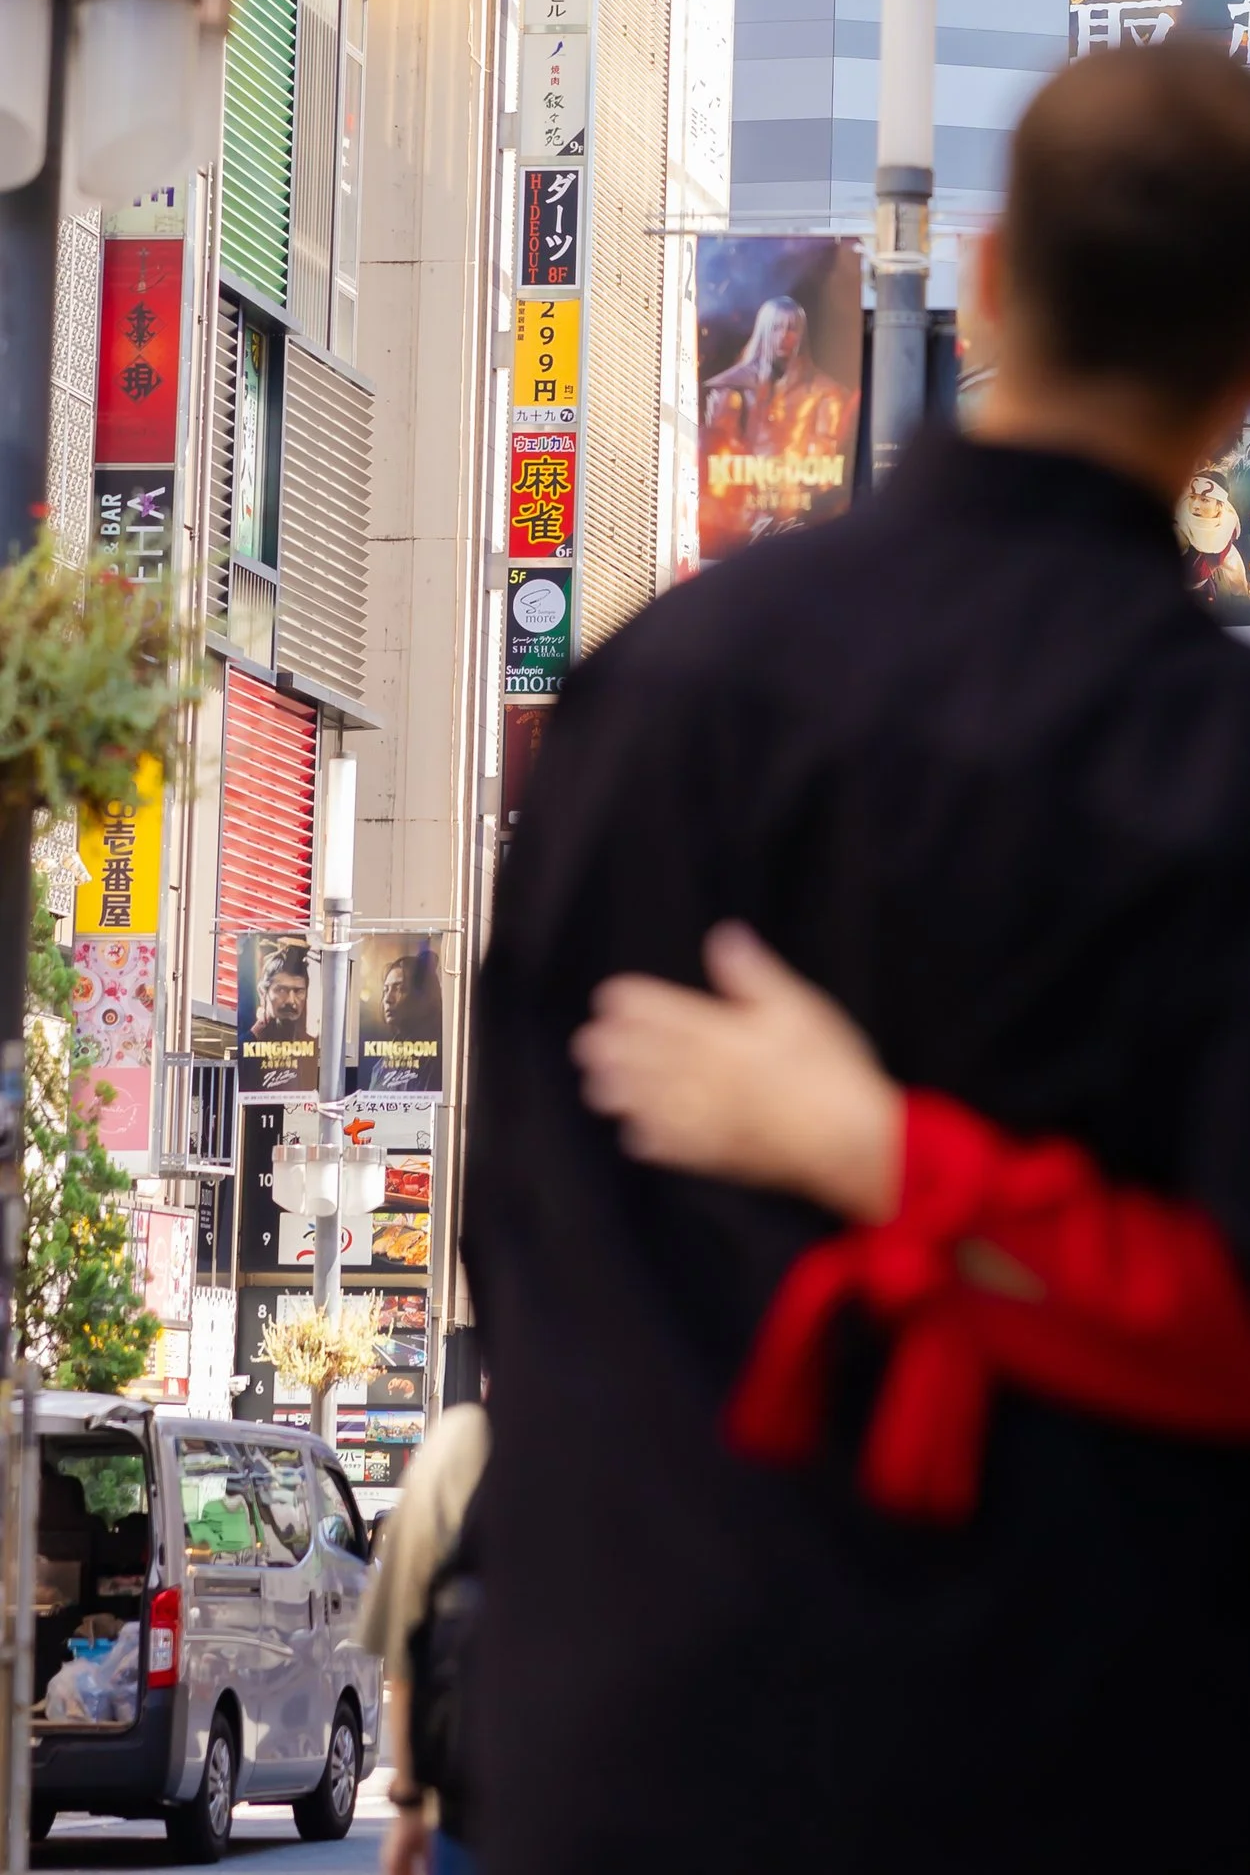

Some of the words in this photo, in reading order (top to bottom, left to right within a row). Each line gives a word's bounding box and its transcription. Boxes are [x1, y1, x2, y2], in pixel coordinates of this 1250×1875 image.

[551, 65, 560, 86] 焼肉
[569, 140, 584, 153] 9F
[545, 173, 577, 262] ダーツ
[528, 173, 541, 284] HIDEOUT
[548, 266, 568, 283] 8F
[533, 301, 557, 402] 299円
[516, 409, 557, 423] 九十九
[513, 434, 575, 454] ウェルカム
[707, 453, 845, 487] KINGDOM
[512, 455, 571, 546] 麻雀
[100, 493, 122, 536] BAR
[556, 544, 573, 558] 6F
[508, 570, 527, 584] 5F
[525, 614, 556, 624] more
[512, 635, 565, 645] シーシャラウンジ
[512, 645, 557, 654] SHISHA
[505, 665, 544, 676] Suutopia
[243, 1041, 315, 1058] KINGDOM
[364, 1041, 438, 1057] KINGDOM
[260, 1114, 275, 1129] 11
[258, 1173, 273, 1189] 10
[262, 1232, 271, 1246] 9
[257, 1304, 267, 1319] 8
[255, 1380, 265, 1395] 6
